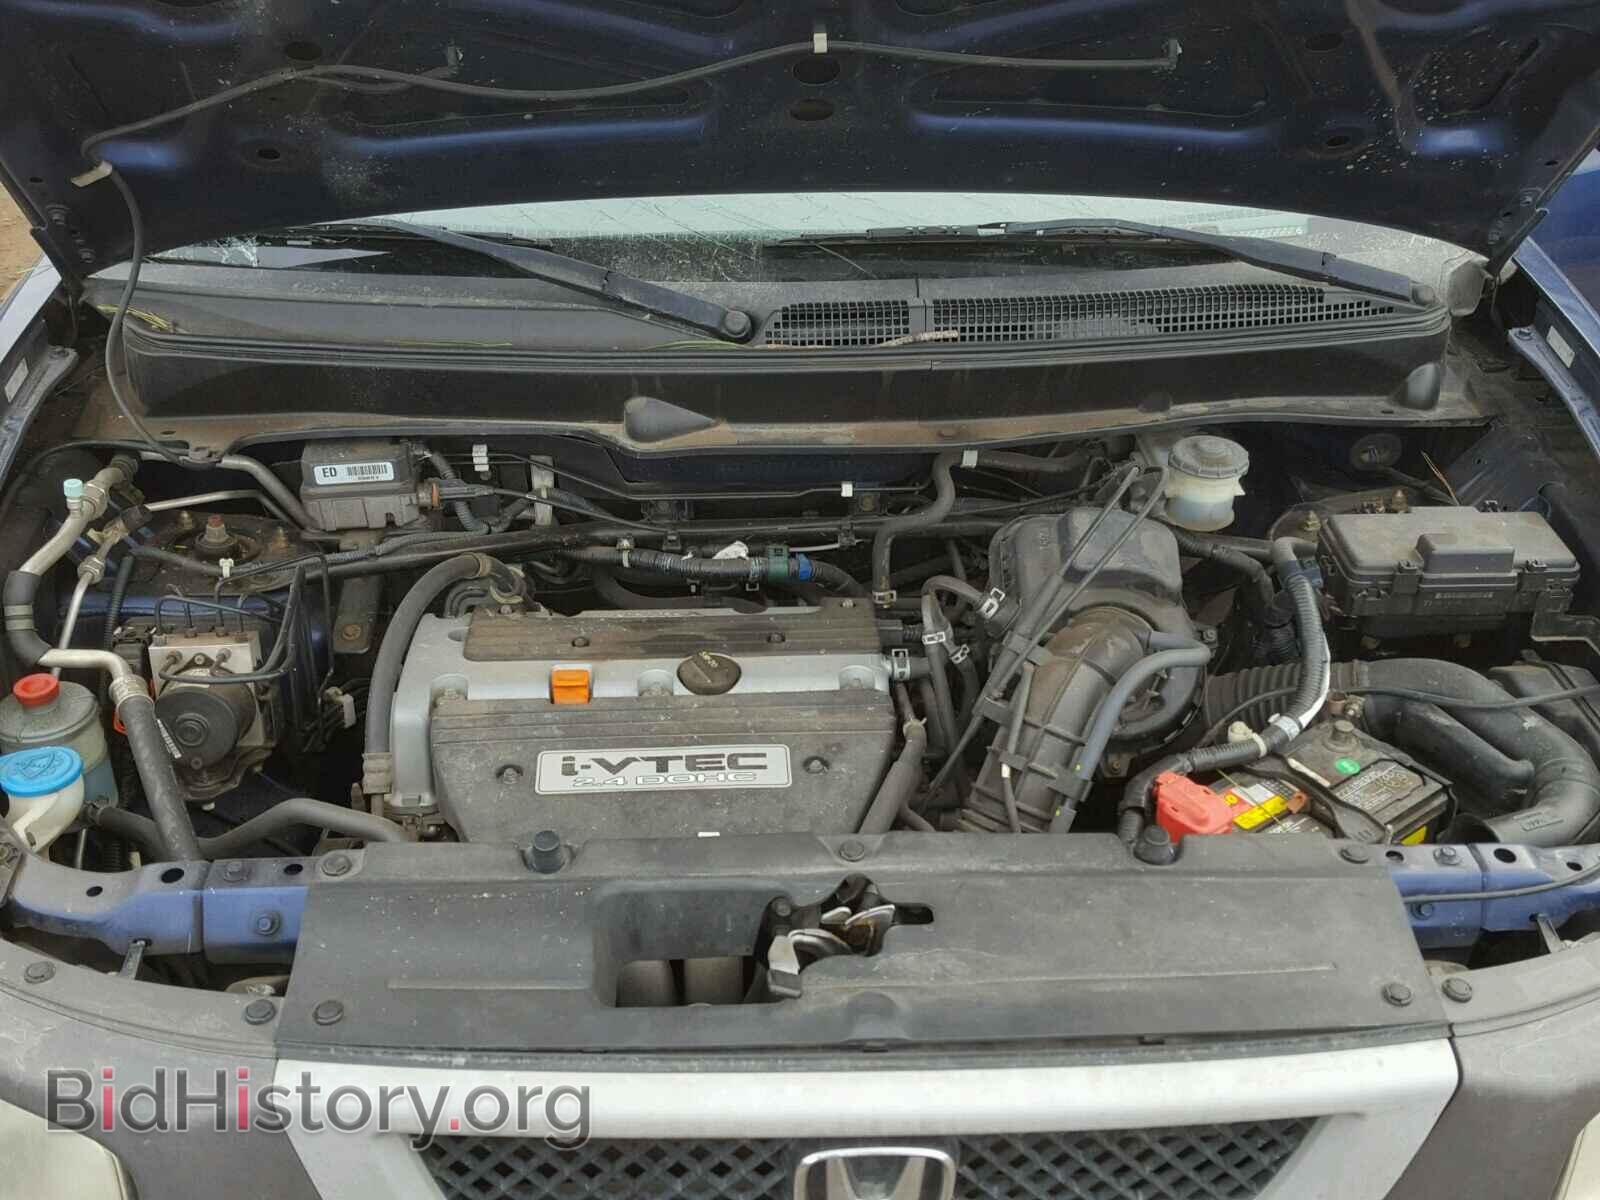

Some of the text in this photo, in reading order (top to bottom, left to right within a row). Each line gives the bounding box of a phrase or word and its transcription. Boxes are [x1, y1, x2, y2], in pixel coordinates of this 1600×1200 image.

[322, 466, 337, 478] ED
[561, 752, 768, 777] i-VTEC
[572, 771, 757, 788] 2.4 DOHC
